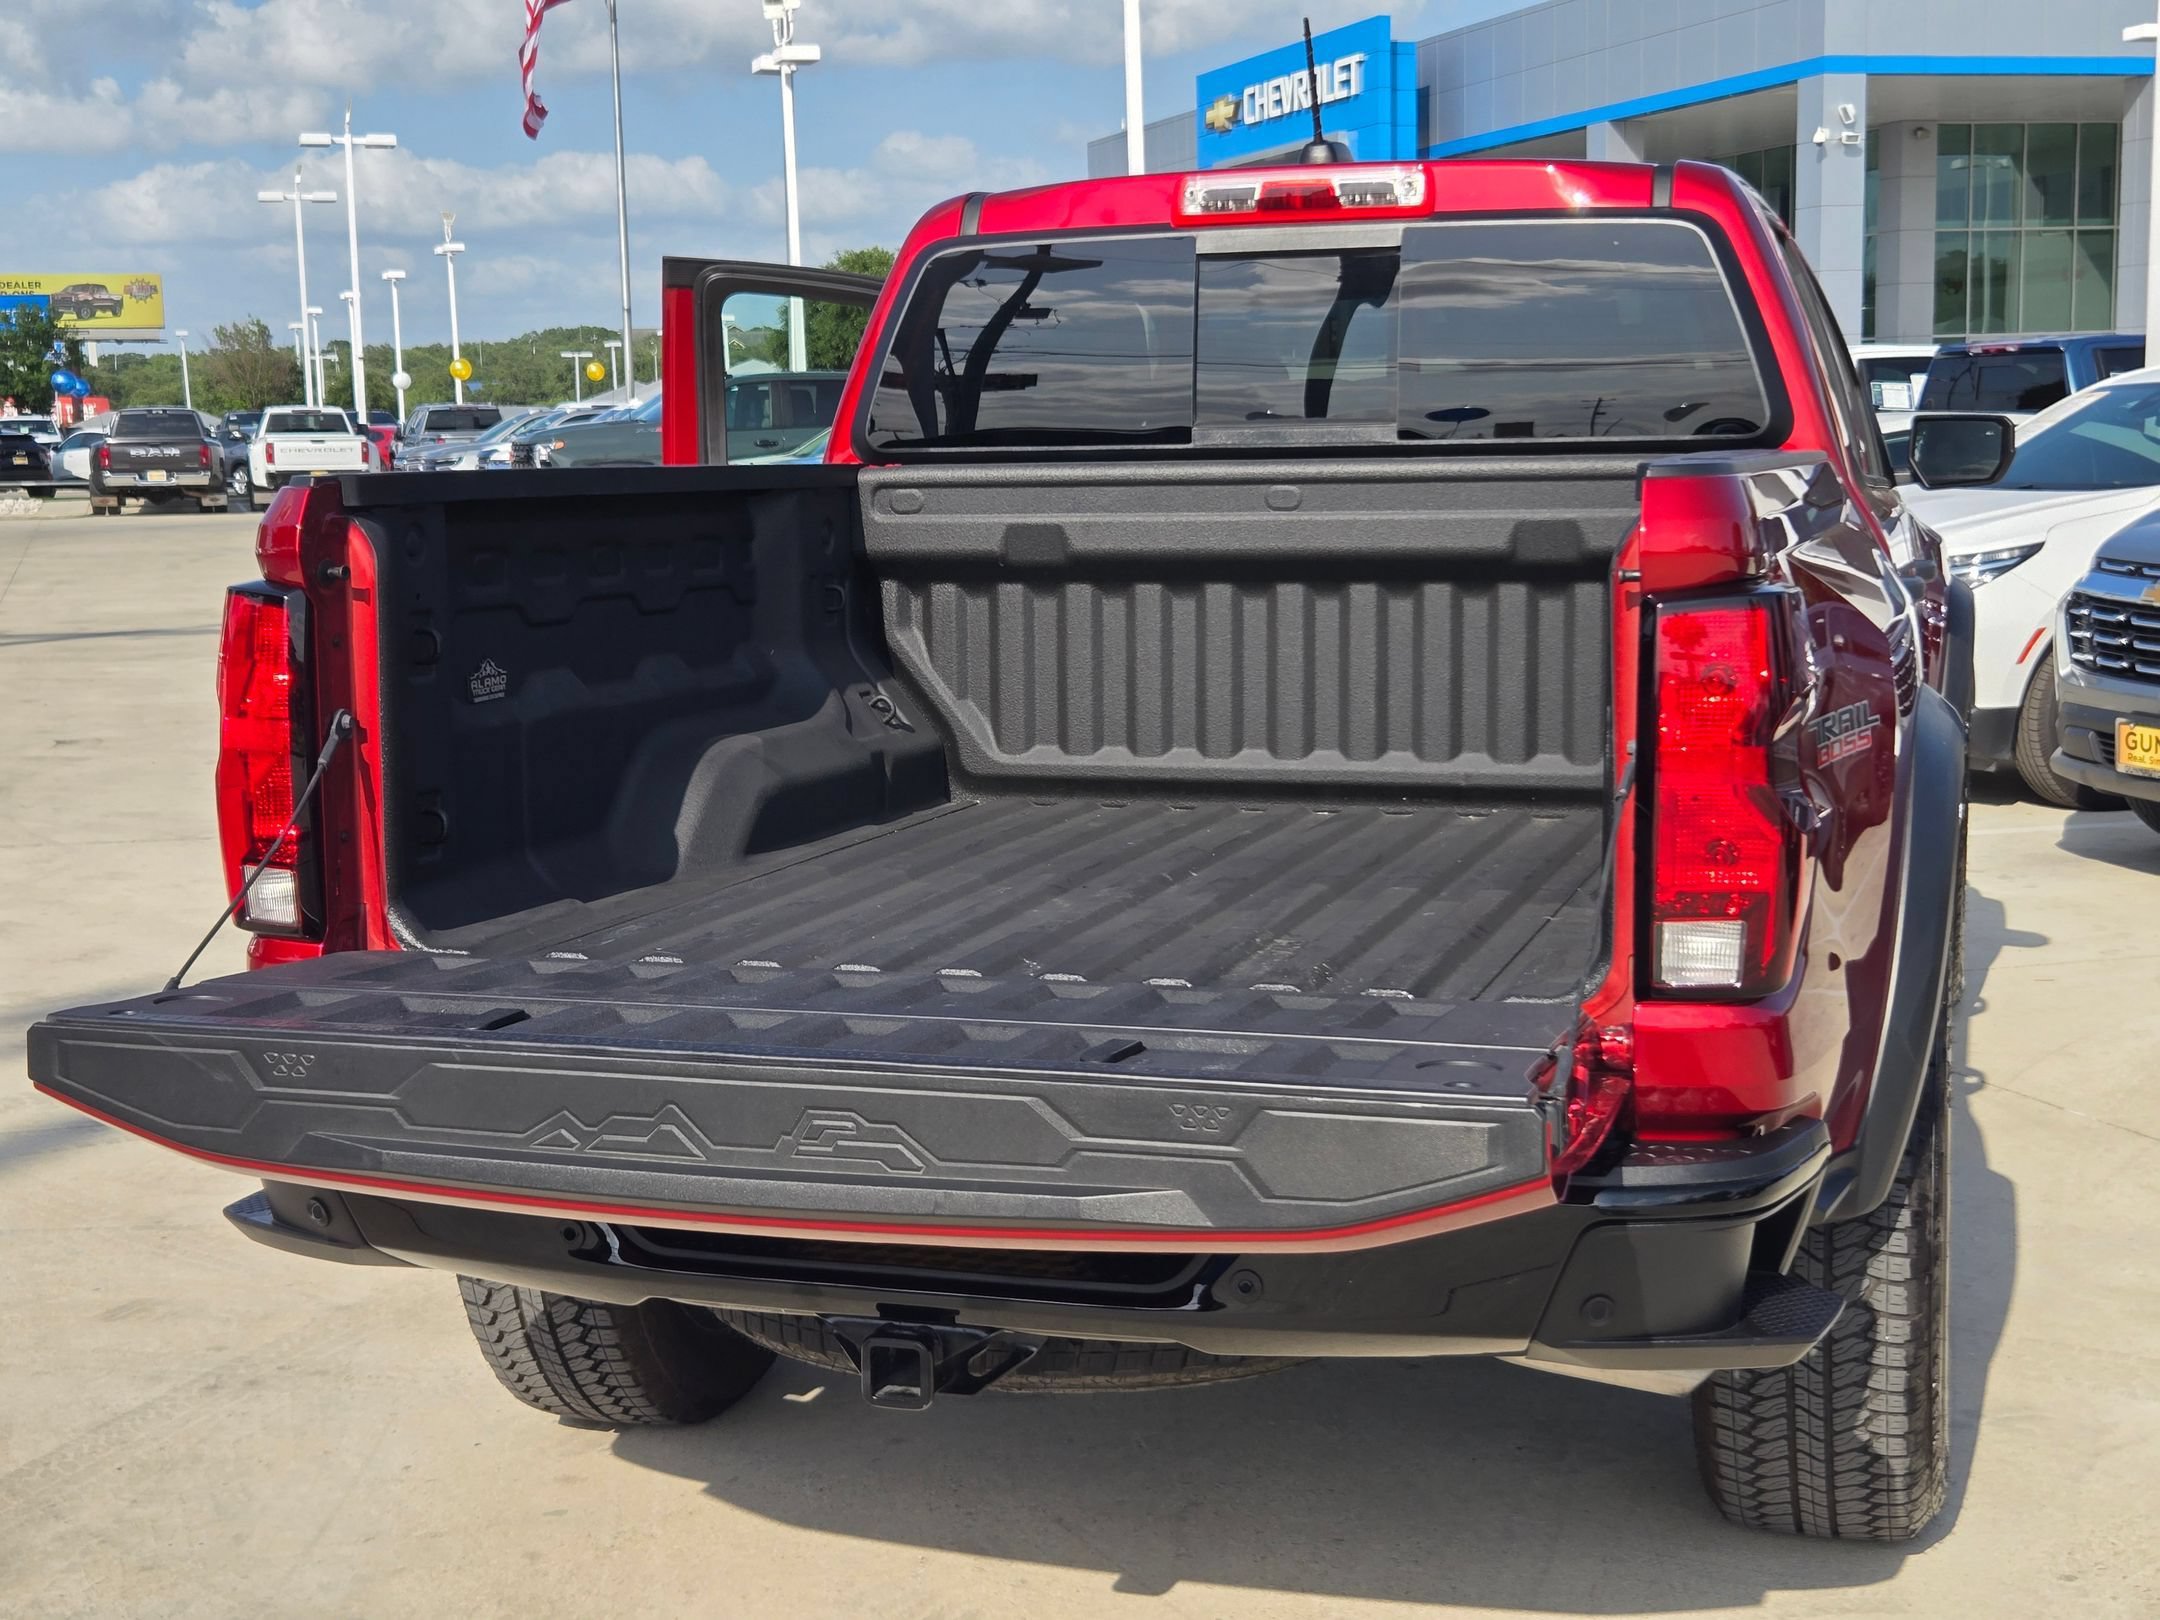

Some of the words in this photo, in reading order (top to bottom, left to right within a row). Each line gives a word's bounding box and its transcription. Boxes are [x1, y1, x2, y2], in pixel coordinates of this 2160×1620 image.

[1242, 53, 1366, 125] CHEVROLET
[0, 281, 42, 290] DEALER
[130, 447, 180, 458] RAM
[470, 675, 507, 690] ALAMO
[1807, 699, 1880, 748] TRAIL
[1816, 727, 1872, 770] BOSS
